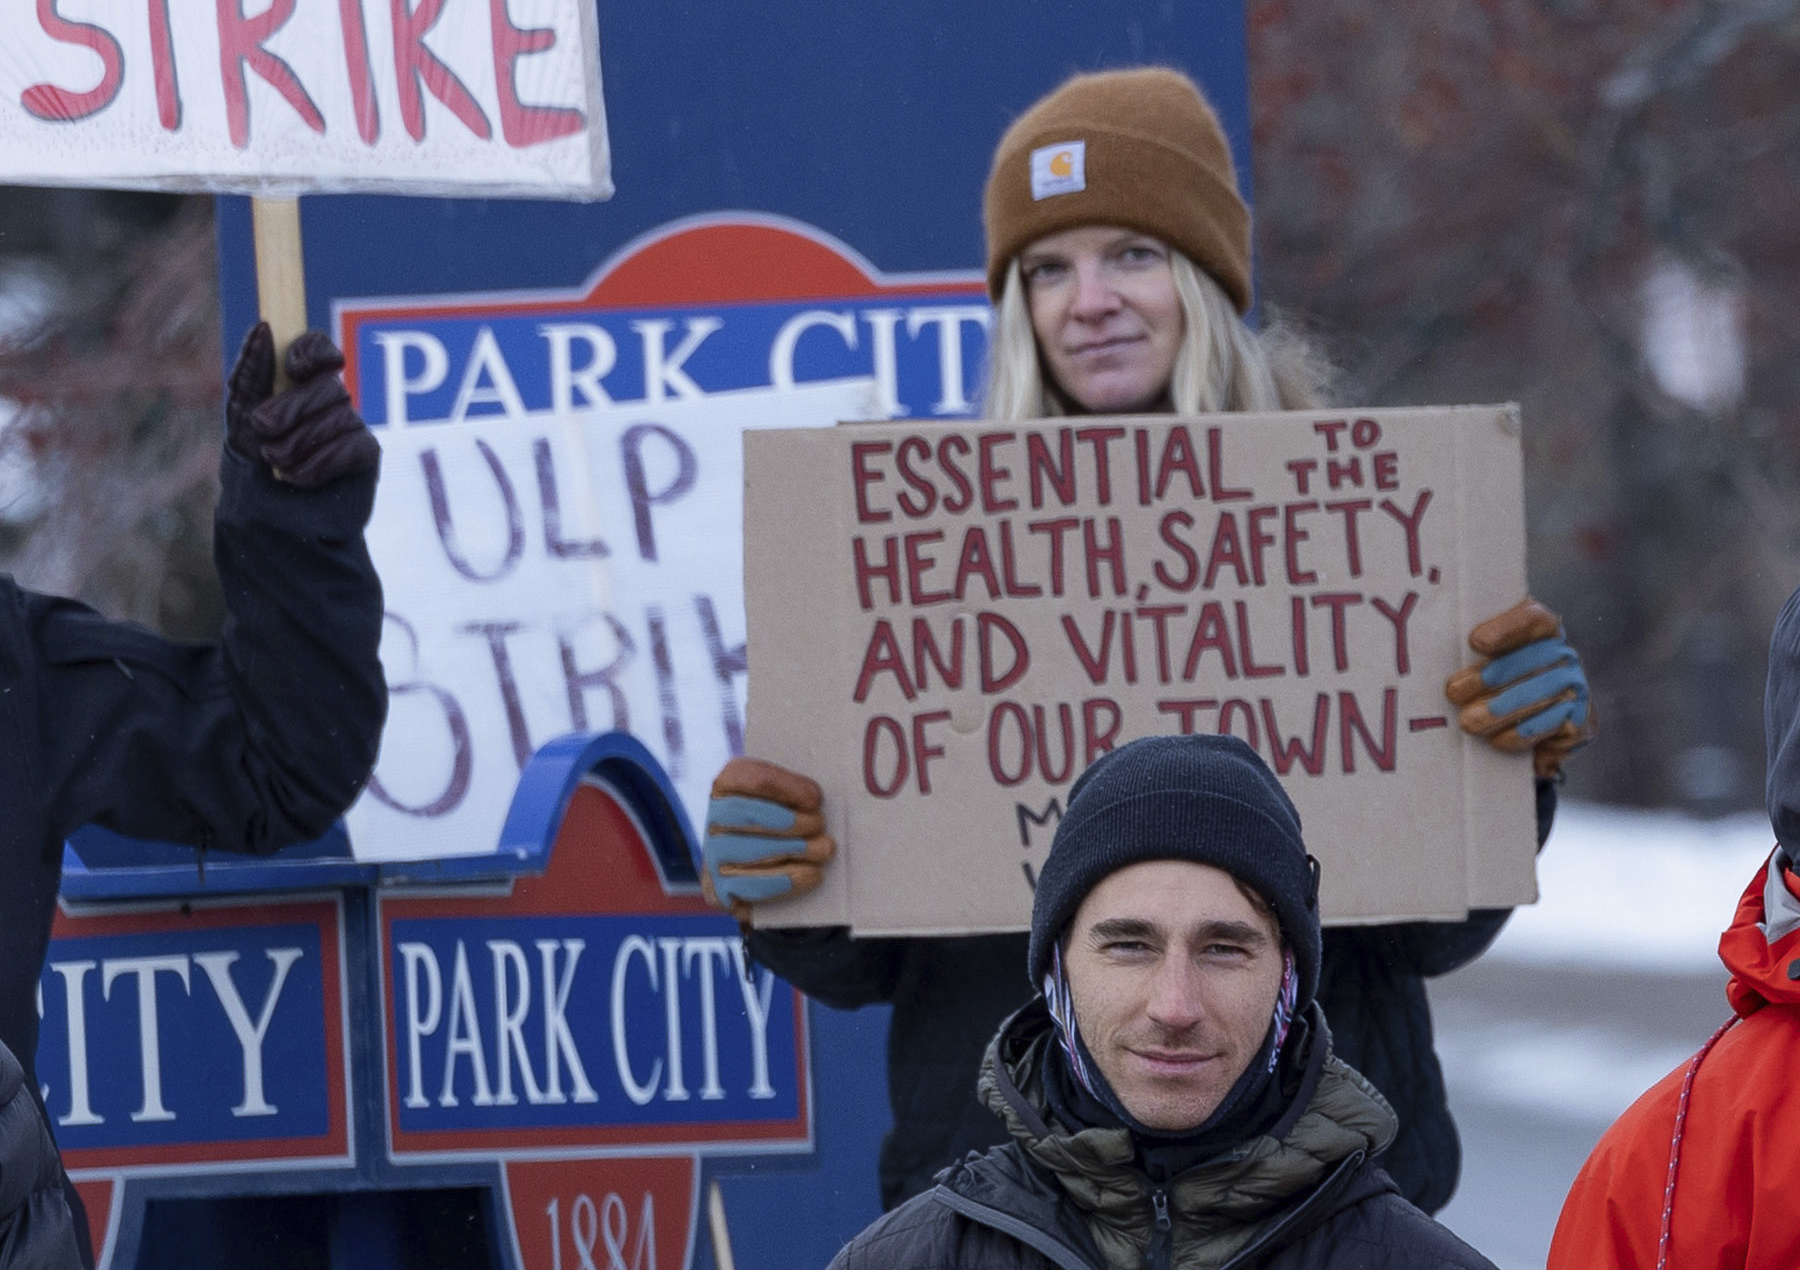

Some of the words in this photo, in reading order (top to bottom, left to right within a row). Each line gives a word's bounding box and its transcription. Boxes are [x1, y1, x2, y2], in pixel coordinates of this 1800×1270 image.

[372, 316, 726, 427] PARK
[851, 424, 1252, 522] ESSENTIAL
[1287, 452, 1400, 495] THE
[1314, 419, 1382, 451] TO
[419, 422, 699, 582] ULP
[853, 518, 1149, 610] HEALTH,
[853, 610, 1029, 703] AND
[1062, 592, 1421, 685] VITALITY
[863, 710, 953, 798] OF
[988, 697, 1124, 786] OUR
[35, 948, 304, 1127] ITY
[399, 938, 599, 1108] PARK
[610, 934, 776, 1105] CITY
